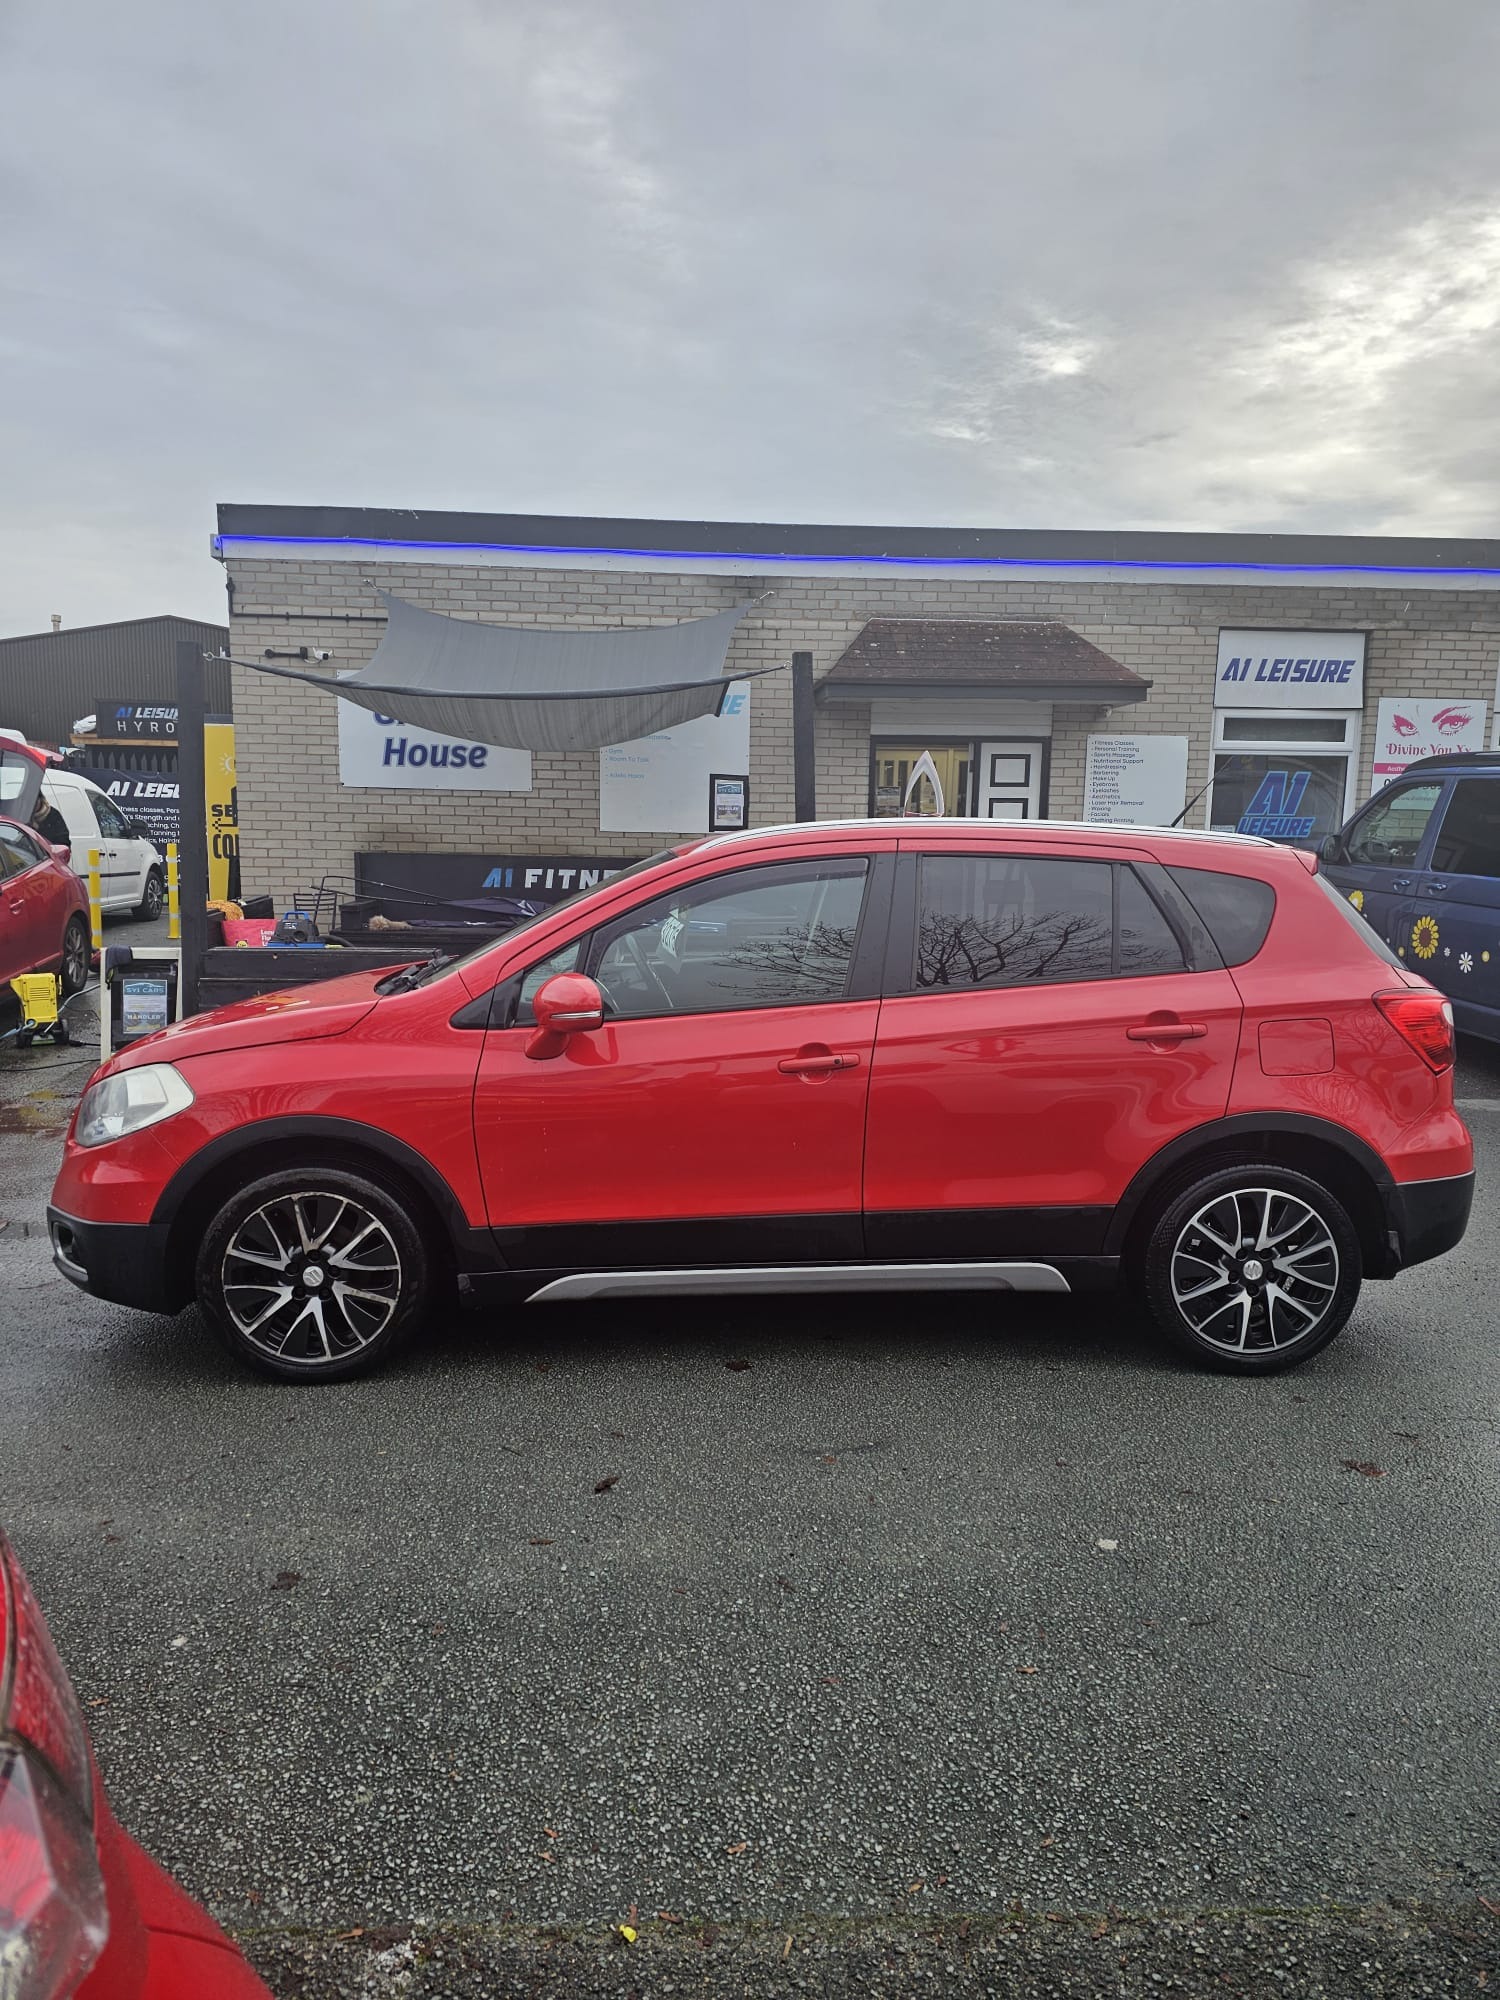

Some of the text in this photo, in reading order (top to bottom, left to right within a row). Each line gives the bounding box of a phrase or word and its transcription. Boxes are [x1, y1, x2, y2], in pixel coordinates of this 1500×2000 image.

[1254, 658, 1356, 683] LEISURE
[383, 736, 488, 769] House
[1386, 743, 1427, 756] Divine
[1236, 816, 1316, 838] LEISURE
